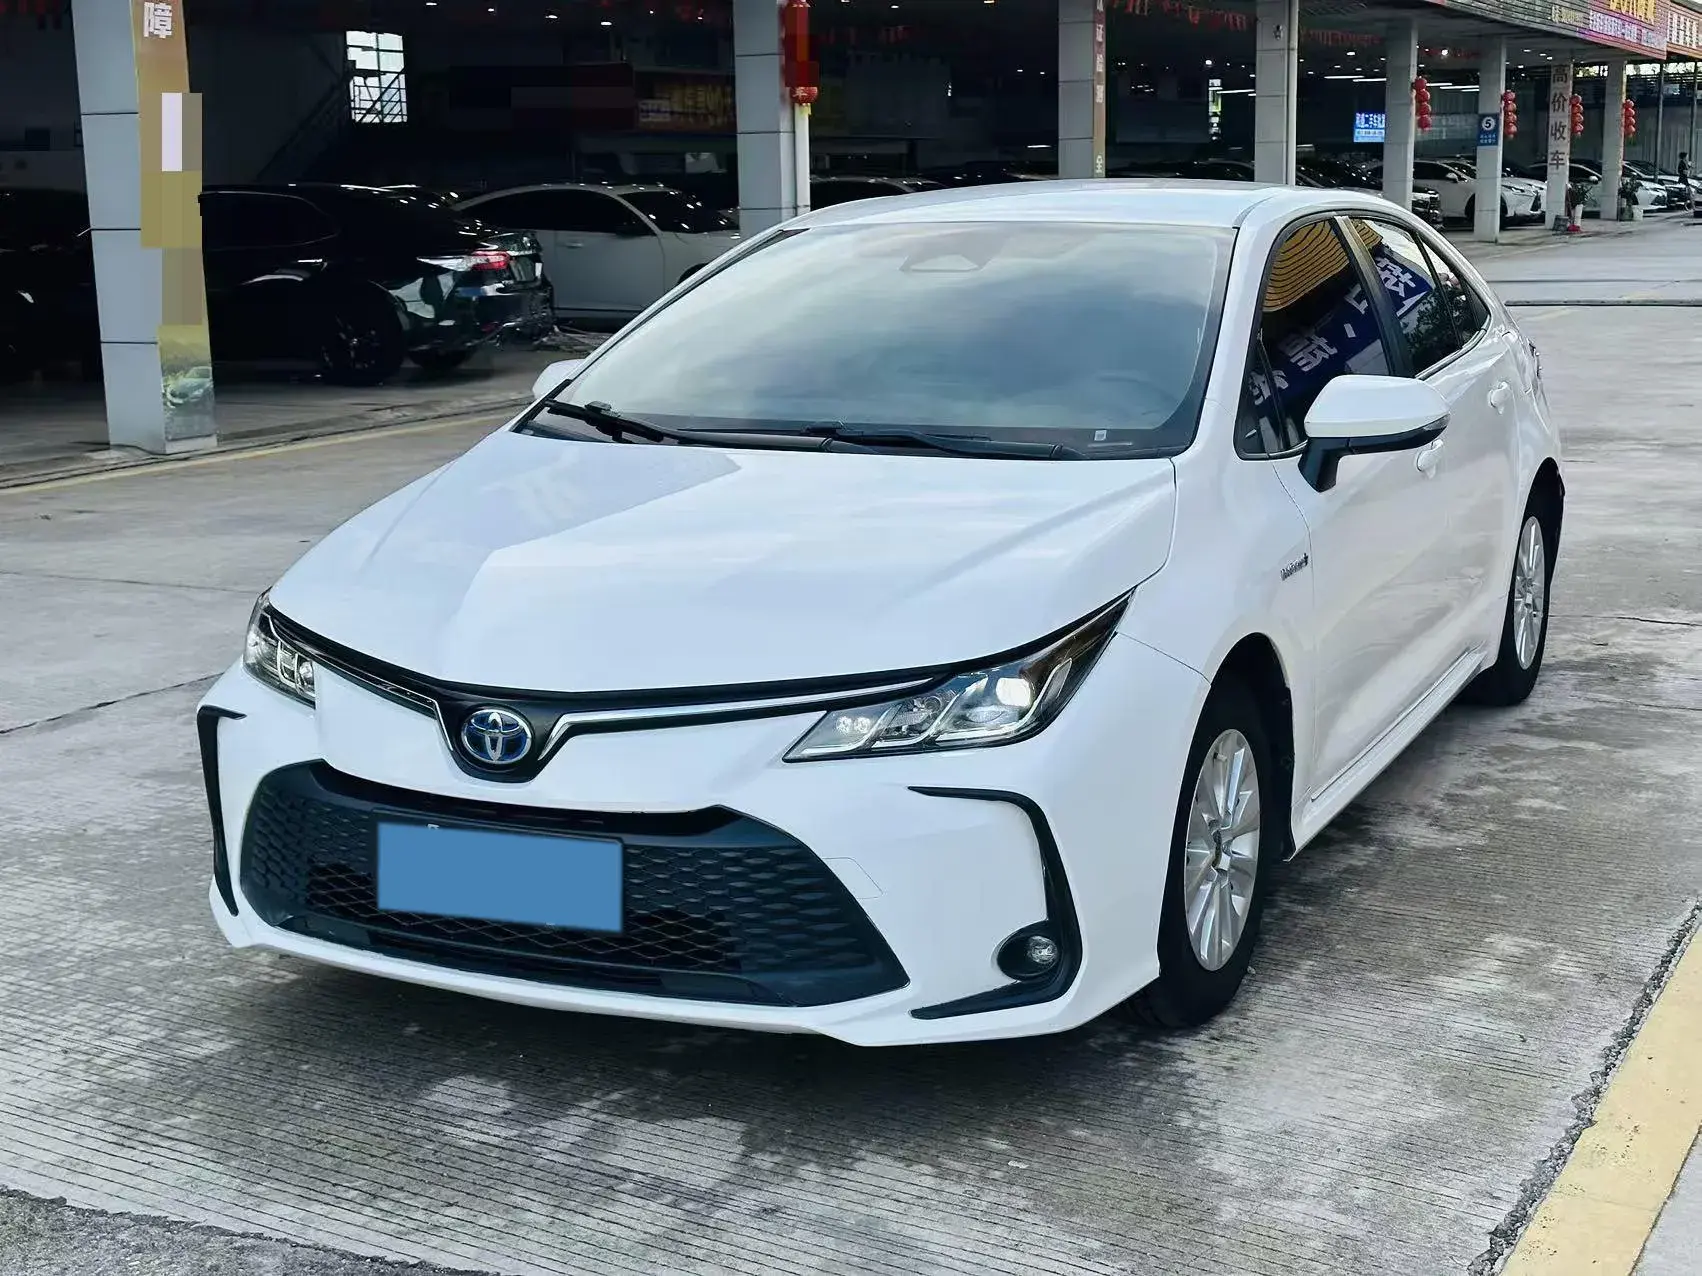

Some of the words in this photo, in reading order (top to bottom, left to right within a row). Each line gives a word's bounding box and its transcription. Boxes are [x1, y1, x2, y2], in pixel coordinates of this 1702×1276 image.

[143, 2, 172, 39] 障
[1484, 118, 1492, 128] 5
[1549, 65, 1570, 170] 高价收车
